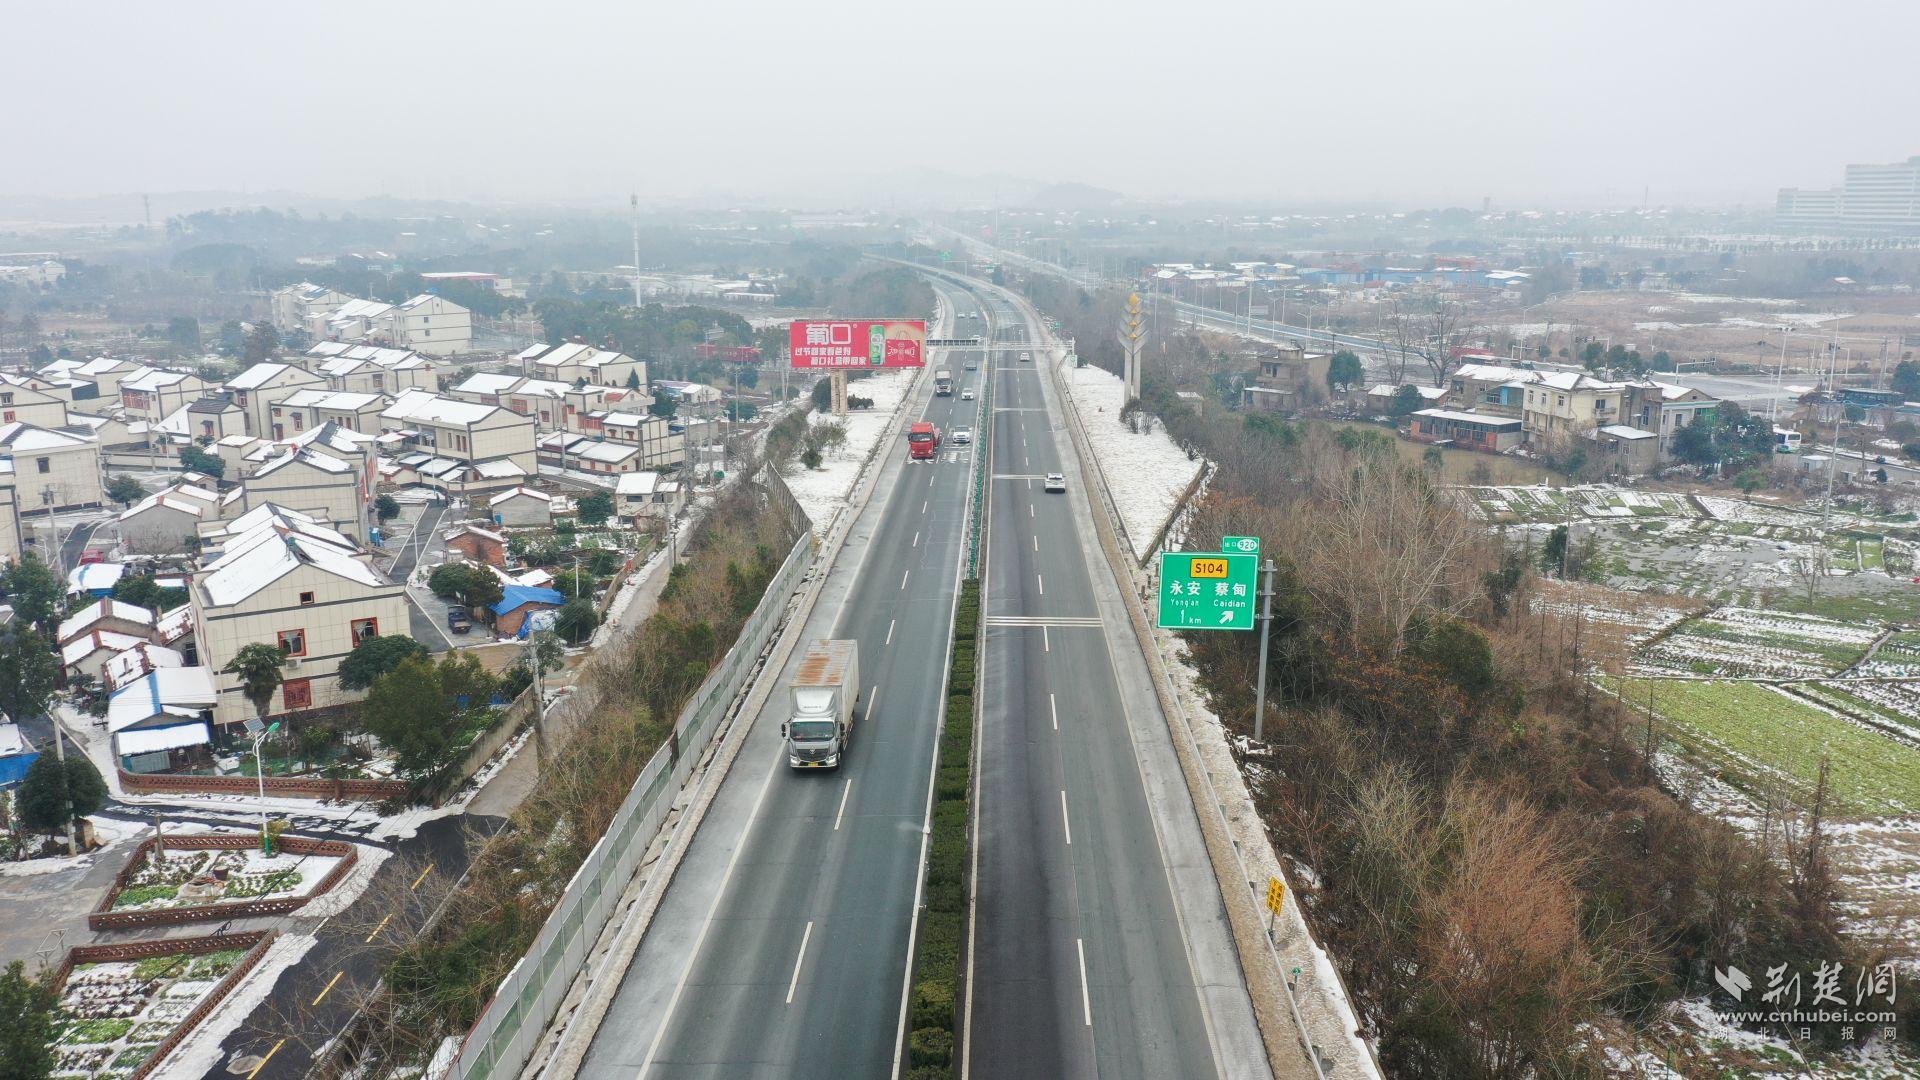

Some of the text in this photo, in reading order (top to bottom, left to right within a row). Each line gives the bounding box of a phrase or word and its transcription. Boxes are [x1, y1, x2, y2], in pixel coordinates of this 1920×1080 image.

[806, 324, 852, 345] 葡口
[1239, 541, 1255, 549] 920
[1195, 563, 1224, 574] S104
[1170, 580, 1246, 597] 永安 蔡甸
[1213, 599, 1246, 608] Caidian
[1180, 609, 1202, 624] 1 km
